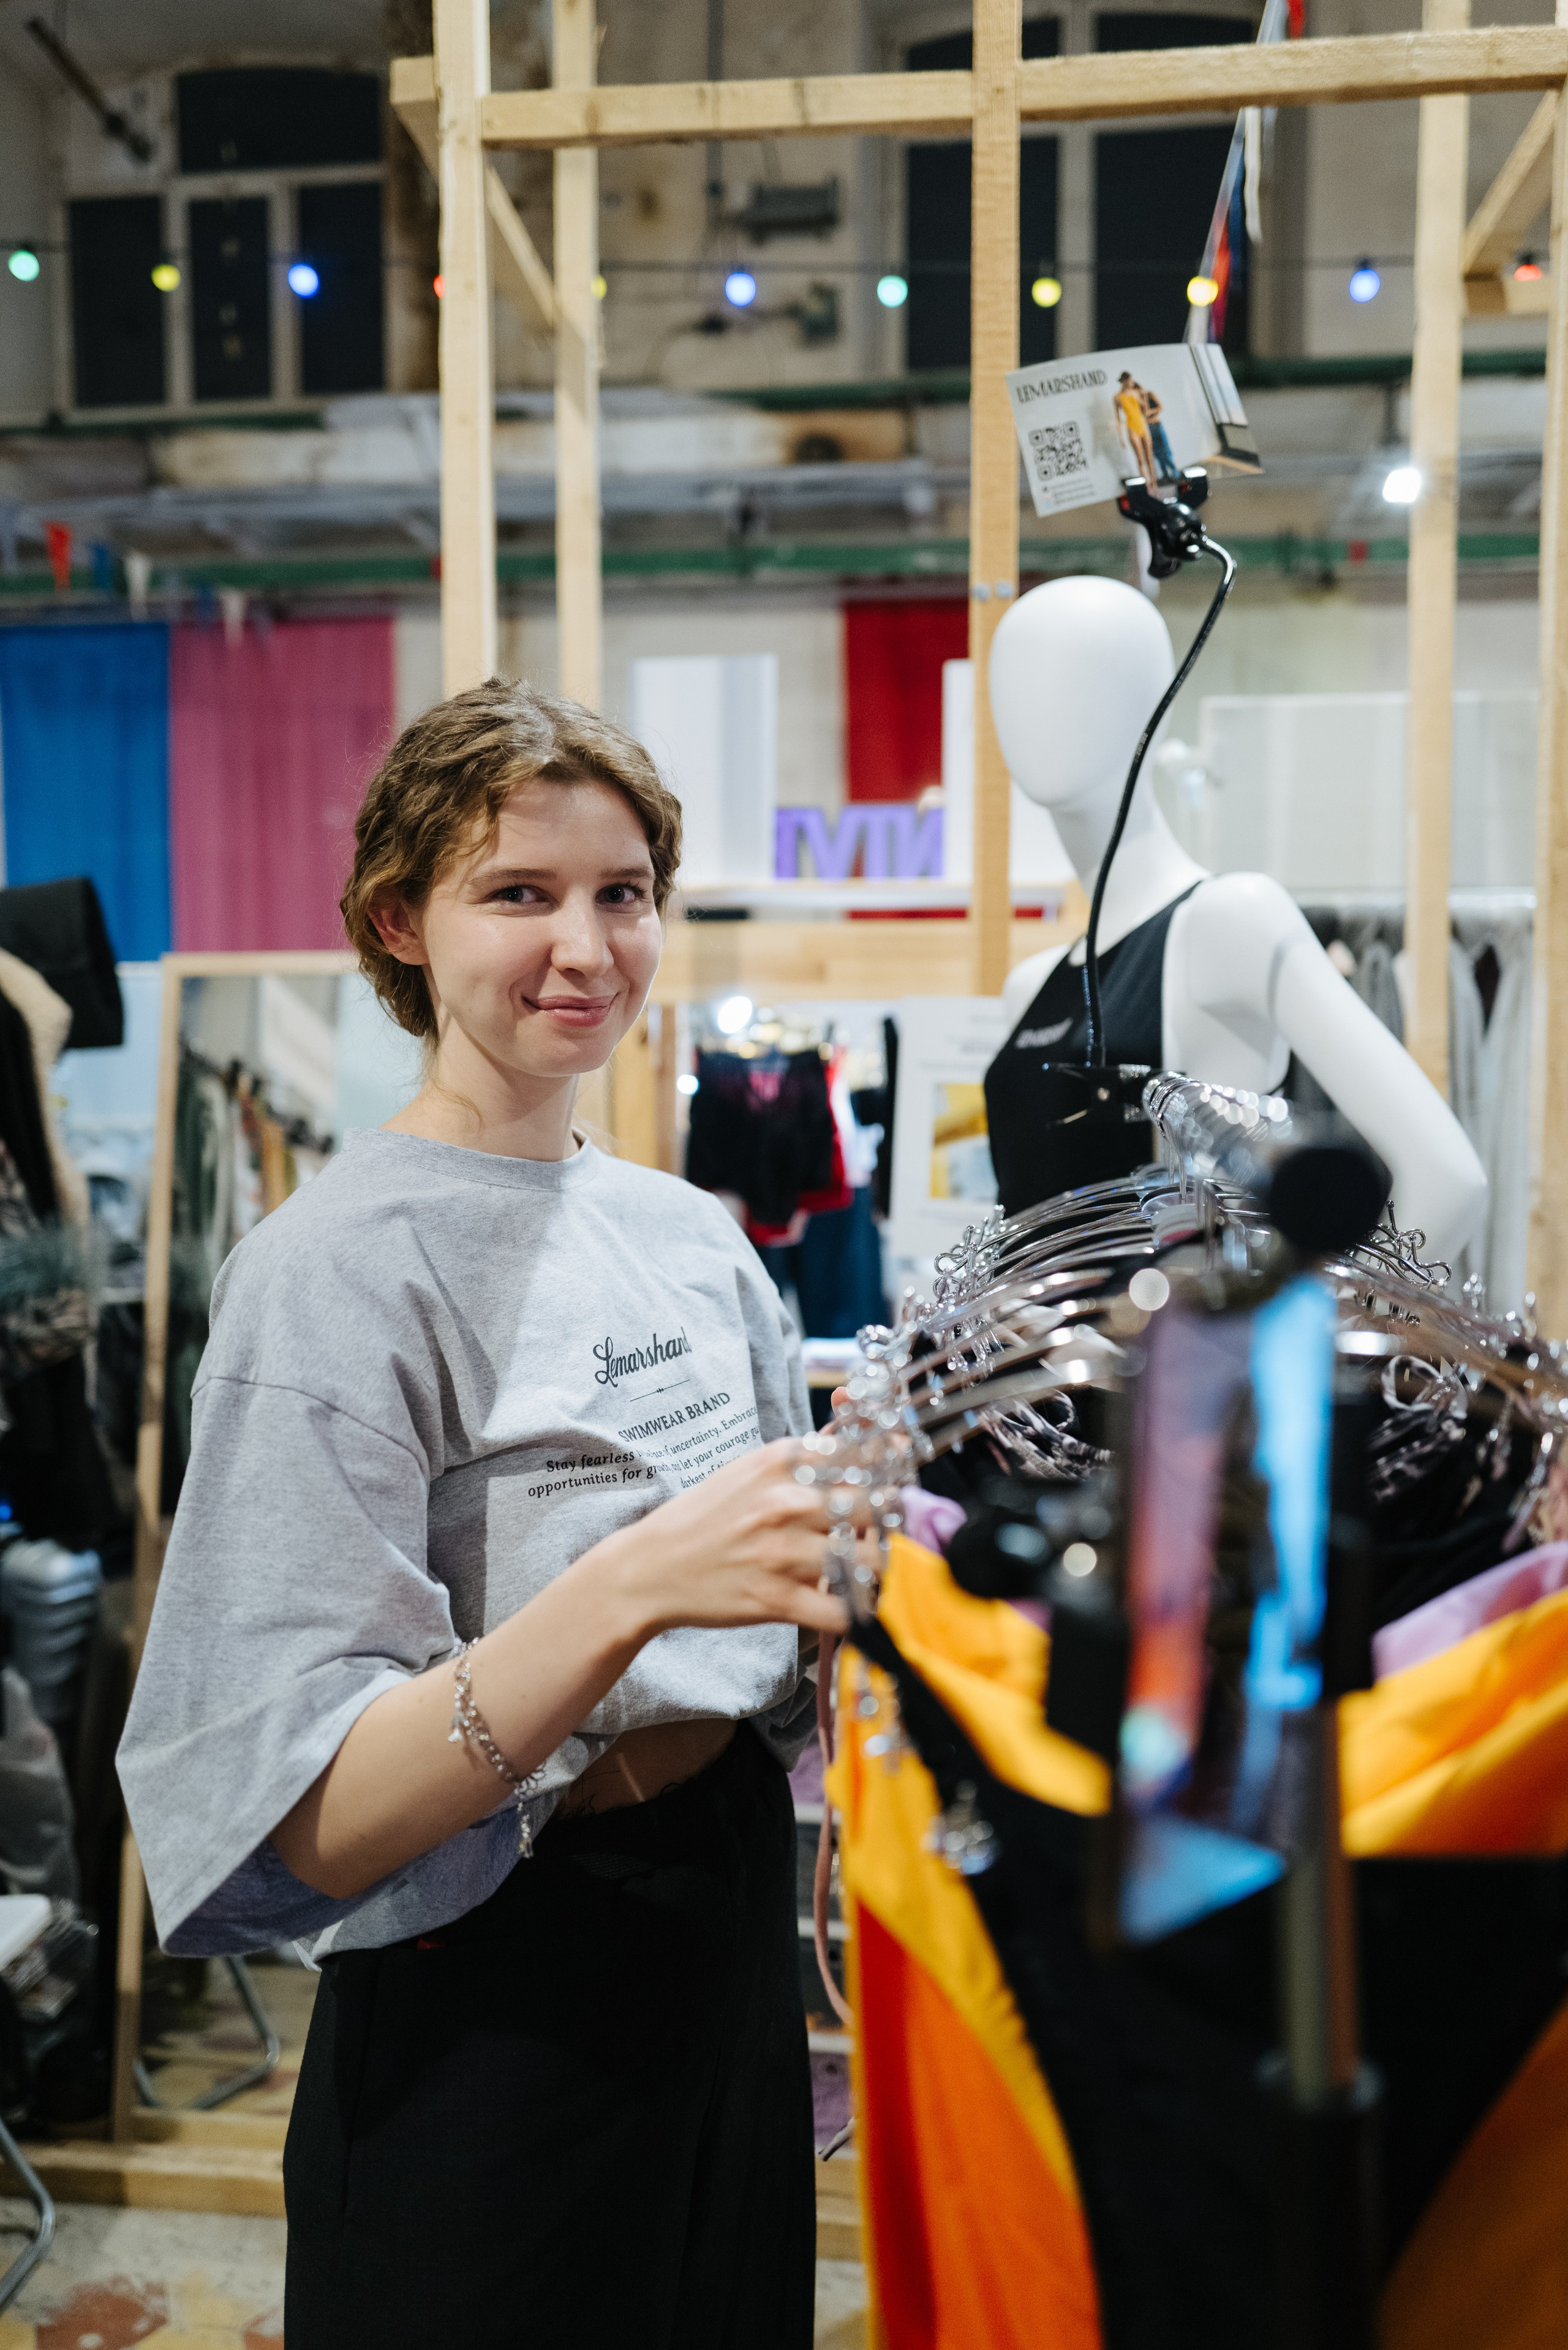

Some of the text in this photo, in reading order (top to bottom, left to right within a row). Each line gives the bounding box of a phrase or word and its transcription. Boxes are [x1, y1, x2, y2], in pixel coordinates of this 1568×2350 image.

[593, 1326, 693, 1388] Lemarshand
[618, 1392, 731, 1443] SWIMWEAR BRAND
[528, 1472, 617, 1499] opportunities
[622, 1467, 642, 1483] for
[679, 1459, 693, 1470] let
[693, 1449, 714, 1467] your
[715, 1430, 750, 1454] courage
[546, 1459, 576, 1472] Stay
[581, 1451, 635, 1470] fearless
[670, 1427, 722, 1455] uncertainty.
[680, 1471, 706, 1489] darkest
